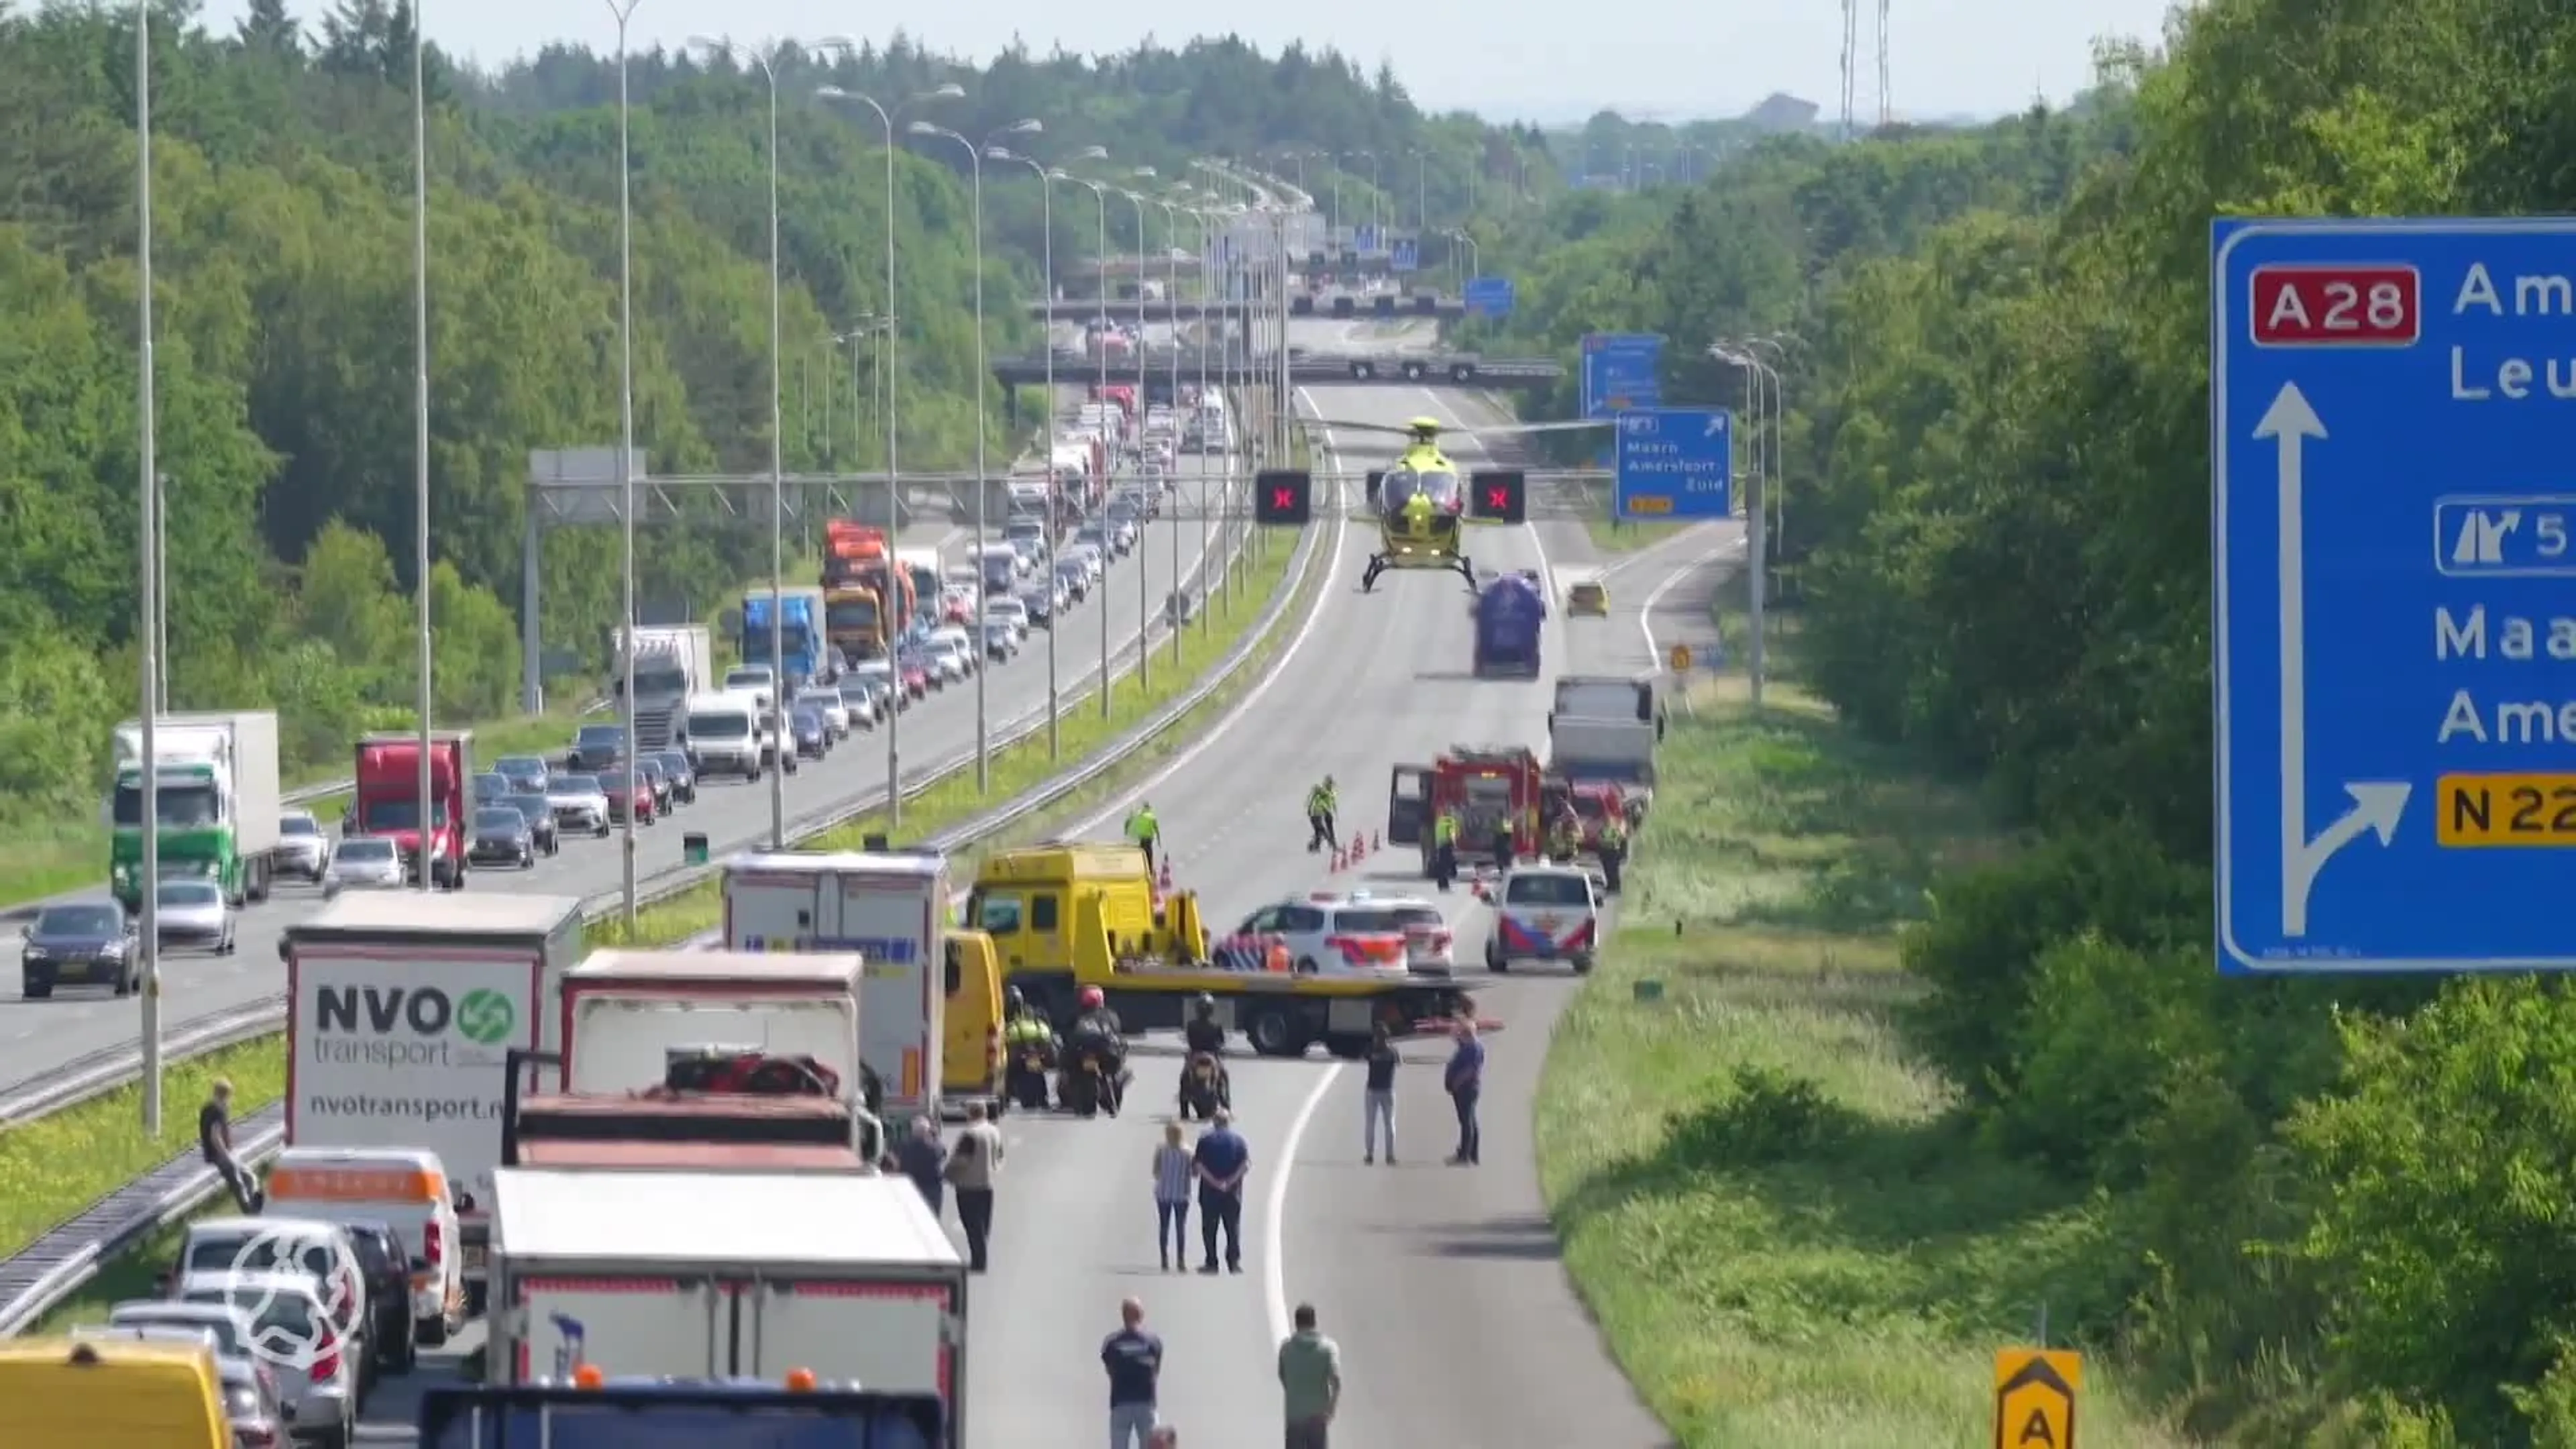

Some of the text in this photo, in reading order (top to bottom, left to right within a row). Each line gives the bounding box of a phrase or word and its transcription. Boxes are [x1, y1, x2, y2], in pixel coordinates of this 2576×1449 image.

[2267, 282, 2404, 330] A28
[2453, 262, 2573, 316] Am
[2451, 345, 2576, 399] Leu
[2536, 514, 2567, 556] 5
[2435, 603, 2576, 660] Maa
[317, 984, 452, 1036] NVO
[314, 1038, 449, 1071] transport
[2019, 1407, 2055, 1449] A
